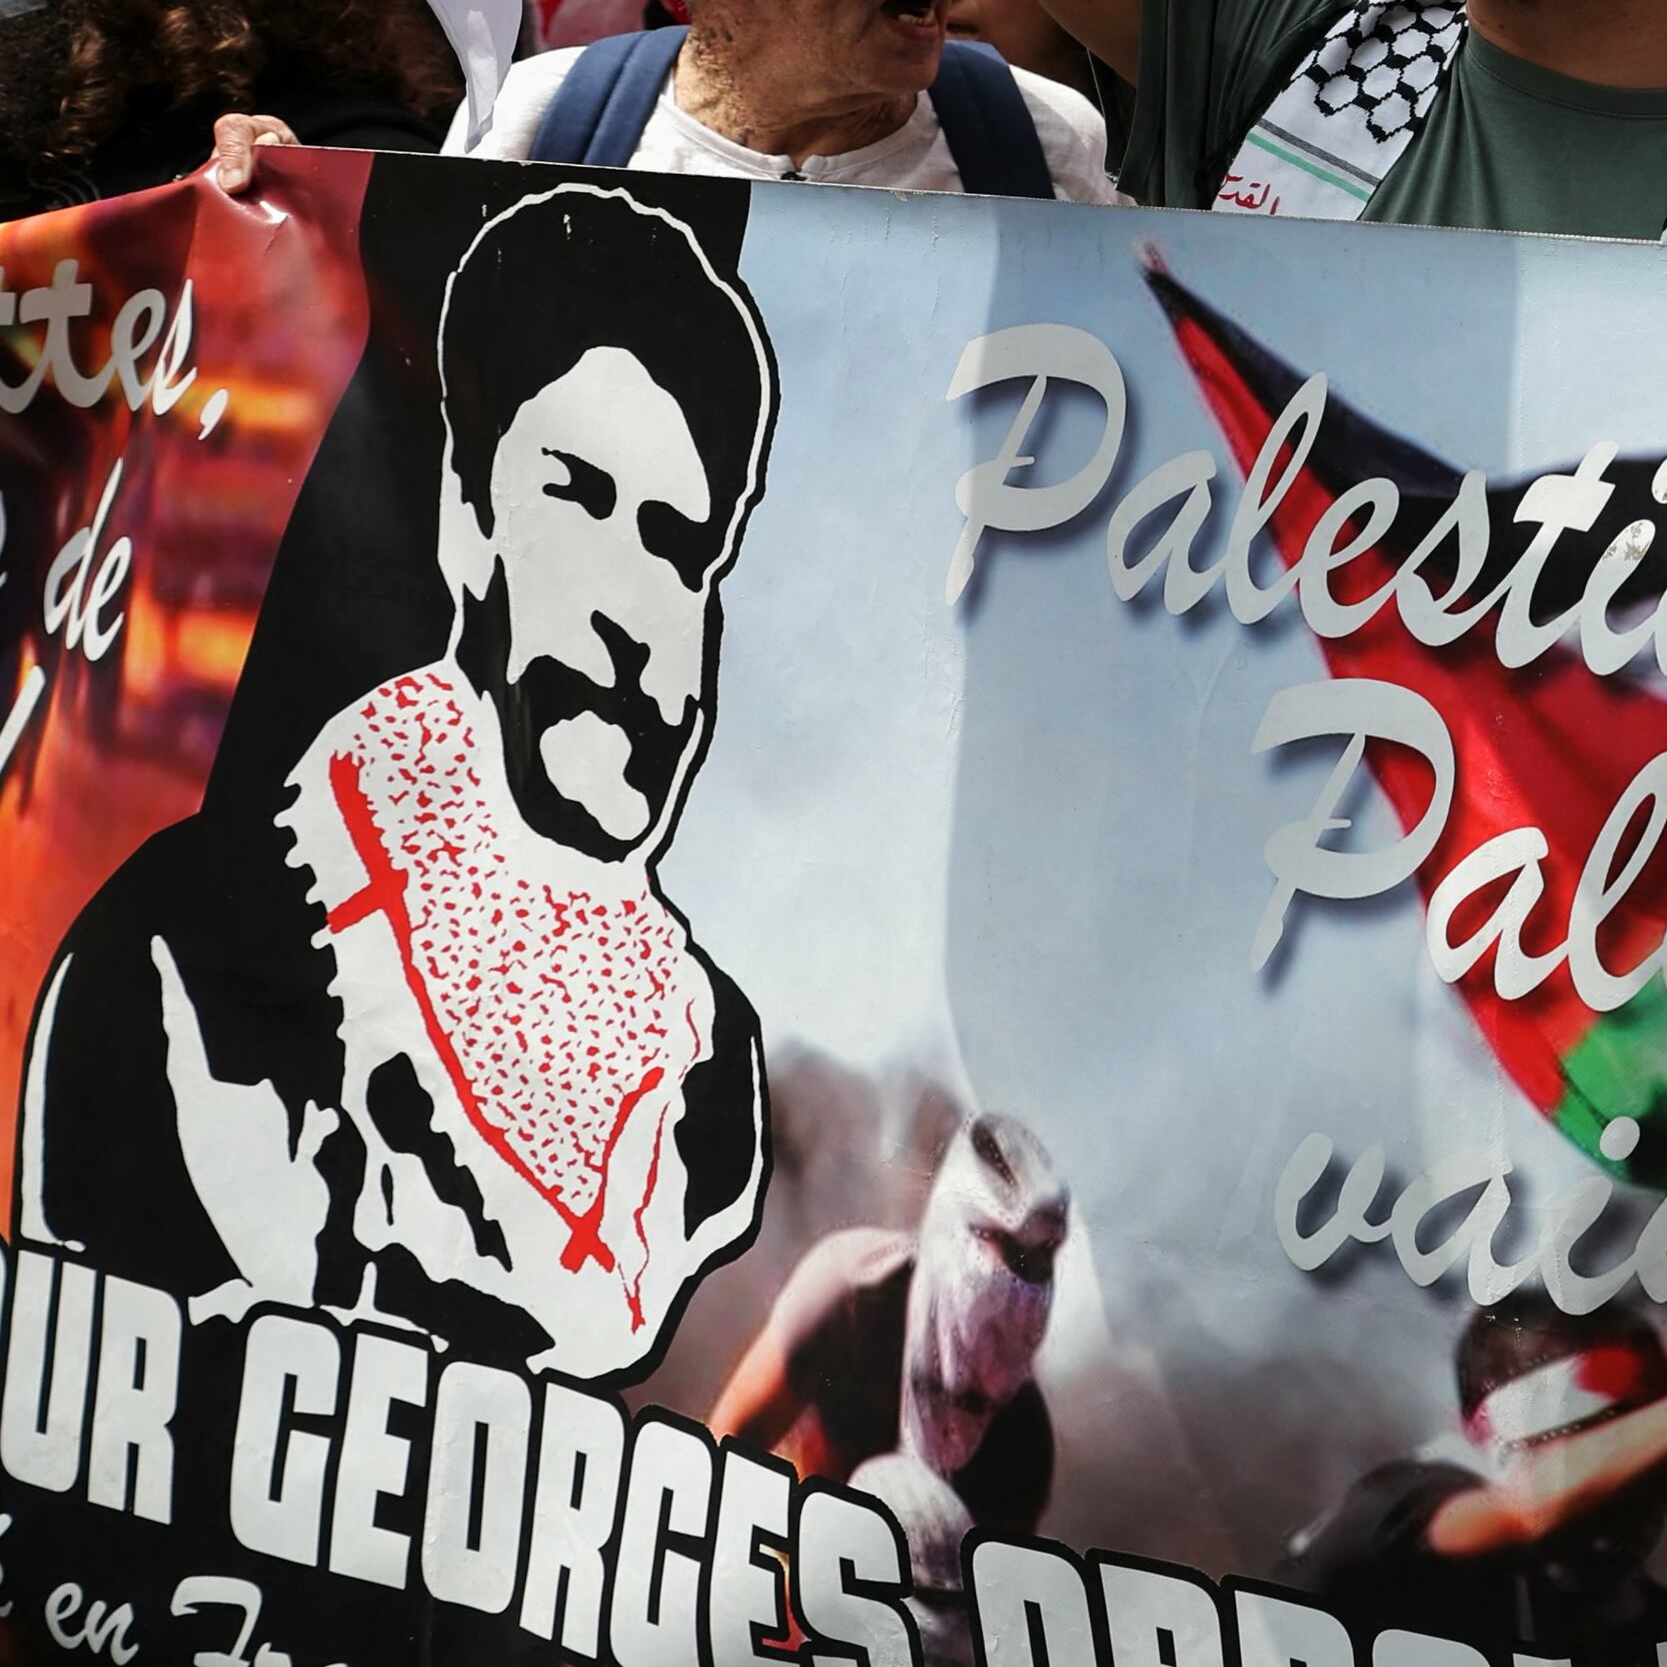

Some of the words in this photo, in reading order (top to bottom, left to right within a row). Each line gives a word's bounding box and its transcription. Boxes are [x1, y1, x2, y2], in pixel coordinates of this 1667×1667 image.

[44, 458, 133, 662] de
[0, 1248, 184, 1524] UR
[229, 1312, 917, 1667] GEORGES
[45, 1582, 140, 1666] en
